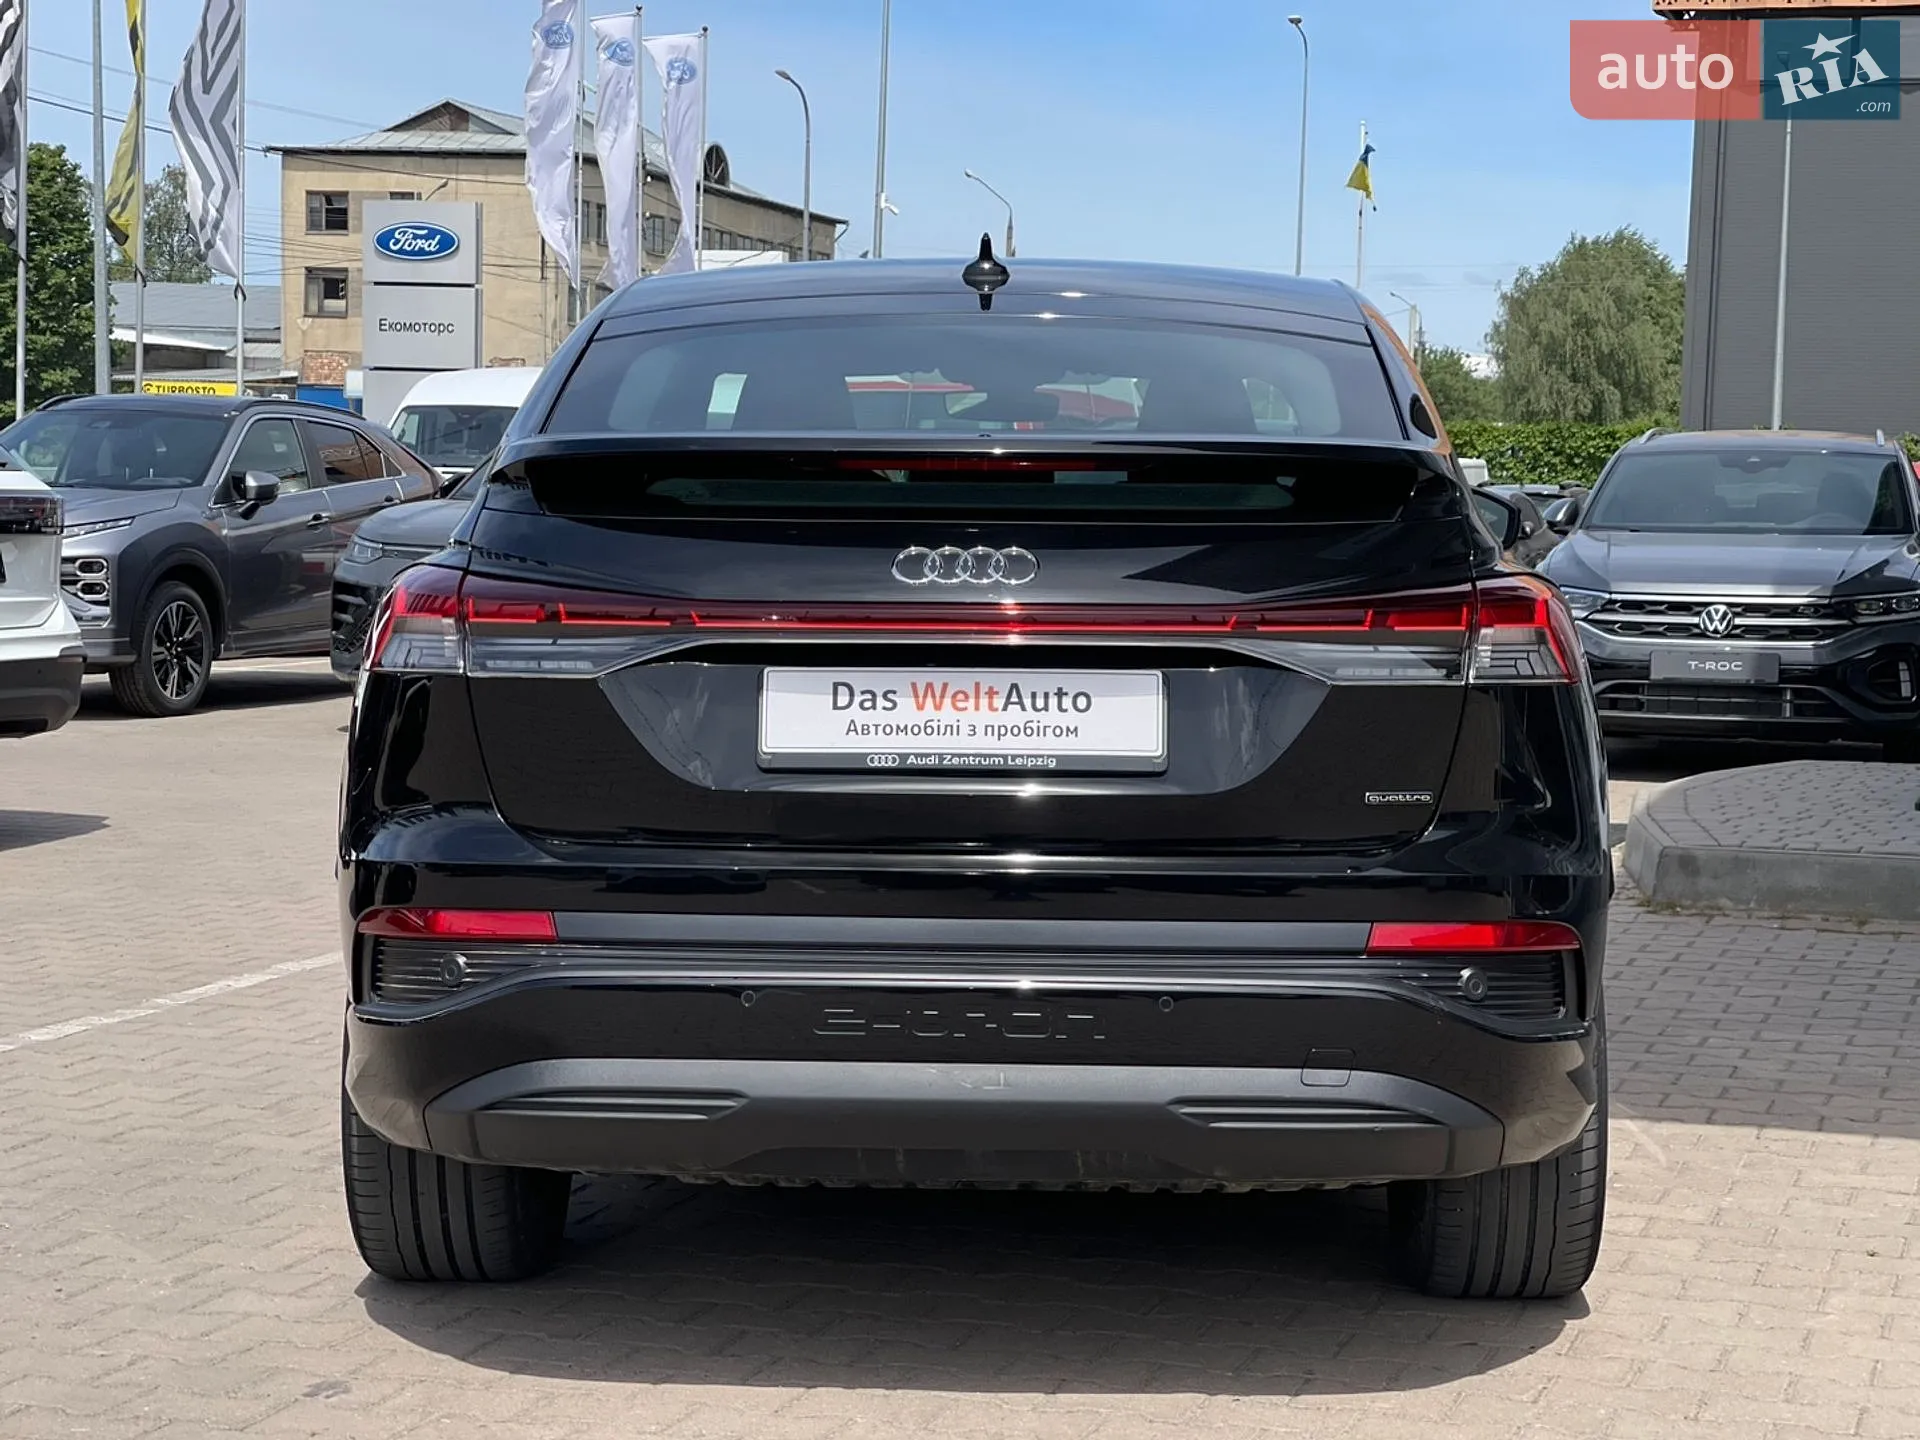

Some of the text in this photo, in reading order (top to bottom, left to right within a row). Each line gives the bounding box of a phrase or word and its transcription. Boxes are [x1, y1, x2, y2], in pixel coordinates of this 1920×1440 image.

[389, 227, 441, 252] Ford
[378, 318, 455, 336] Екомоторс
[1687, 660, 1744, 671] T-ROC
[831, 680, 1093, 714] Das WeltAuto
[845, 718, 1079, 741] Автомобілі з пробігом
[906, 754, 1057, 768] Audi Zentrum Leipzig
[1368, 793, 1431, 804] quattro
